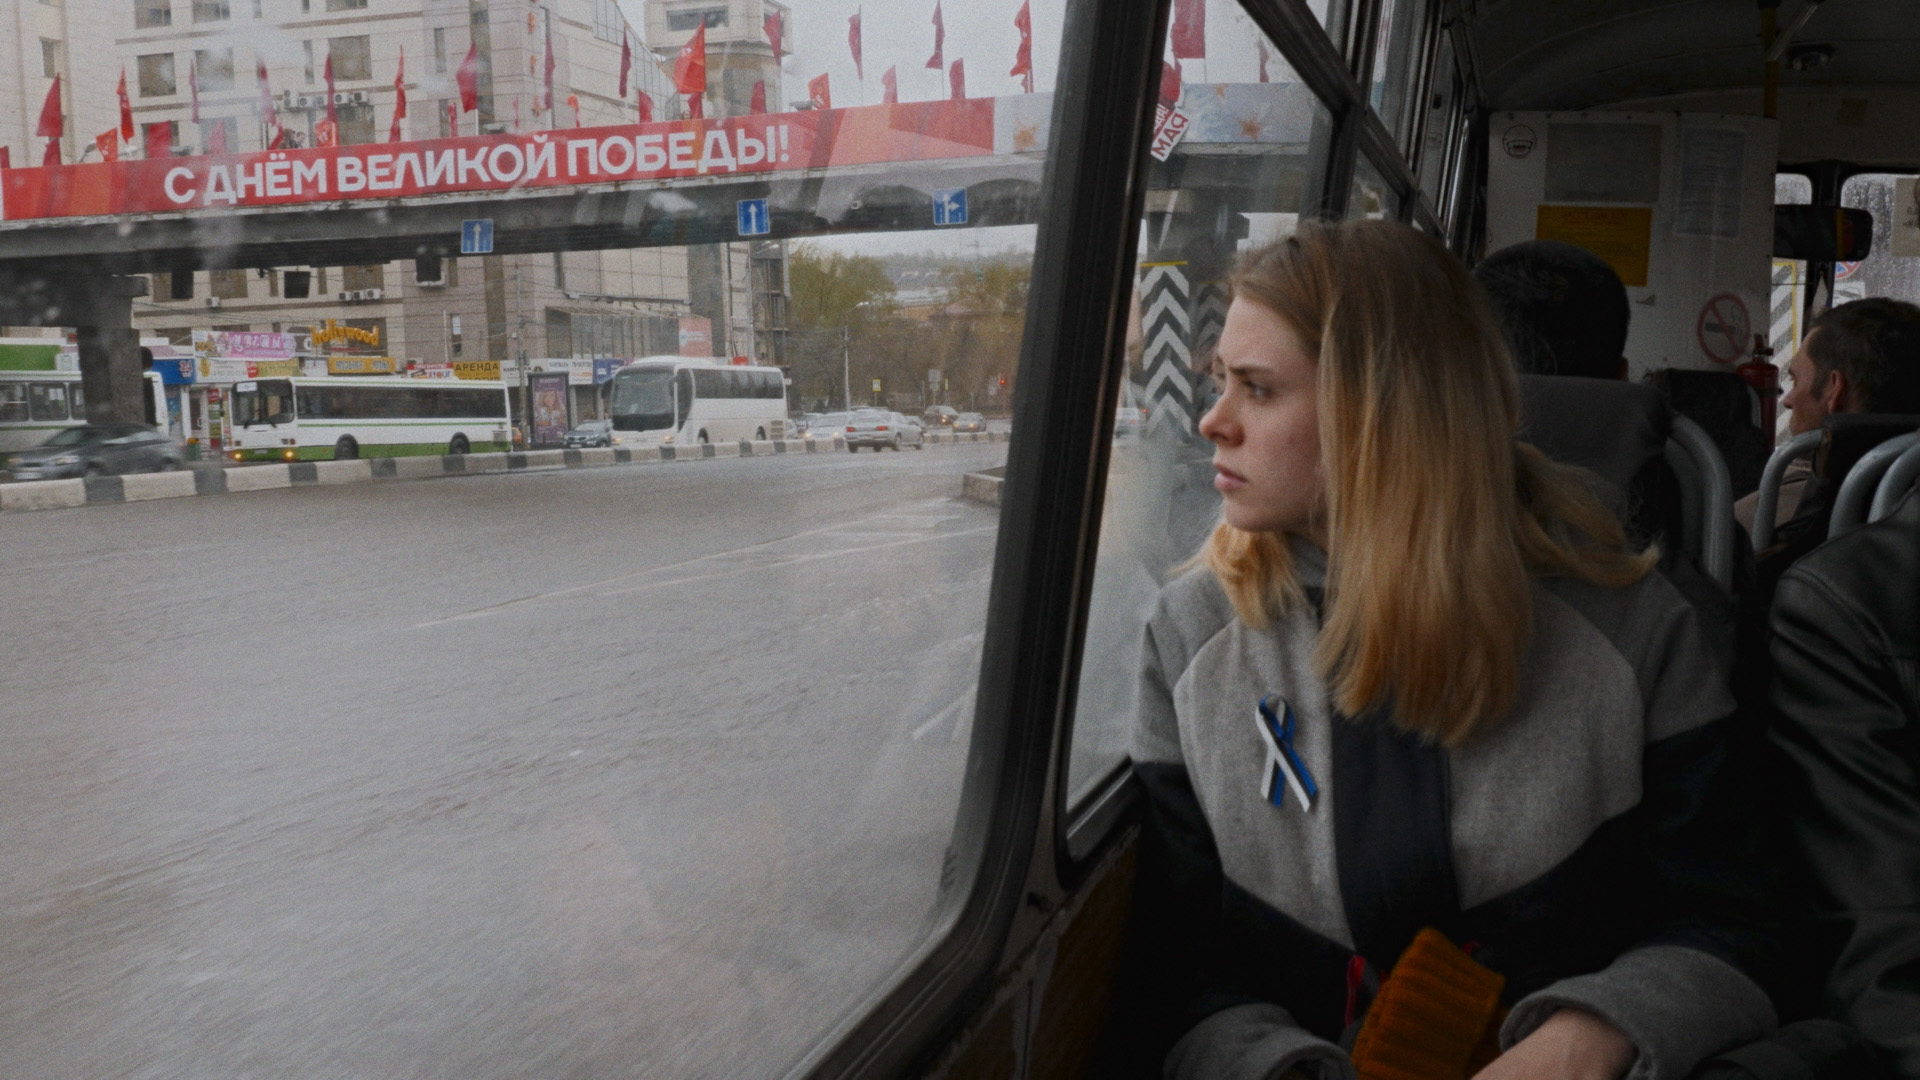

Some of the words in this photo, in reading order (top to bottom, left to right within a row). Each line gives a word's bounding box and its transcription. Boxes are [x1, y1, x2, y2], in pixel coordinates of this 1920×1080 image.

[1152, 113, 1189, 157] МАЯ
[163, 166, 197, 204] С
[203, 152, 328, 205] ДНЁМ
[337, 133, 557, 193] ВЕЛИКОЙ
[567, 125, 789, 176] ПОБЕДЫ!
[455, 362, 499, 372] АРЕНДА
